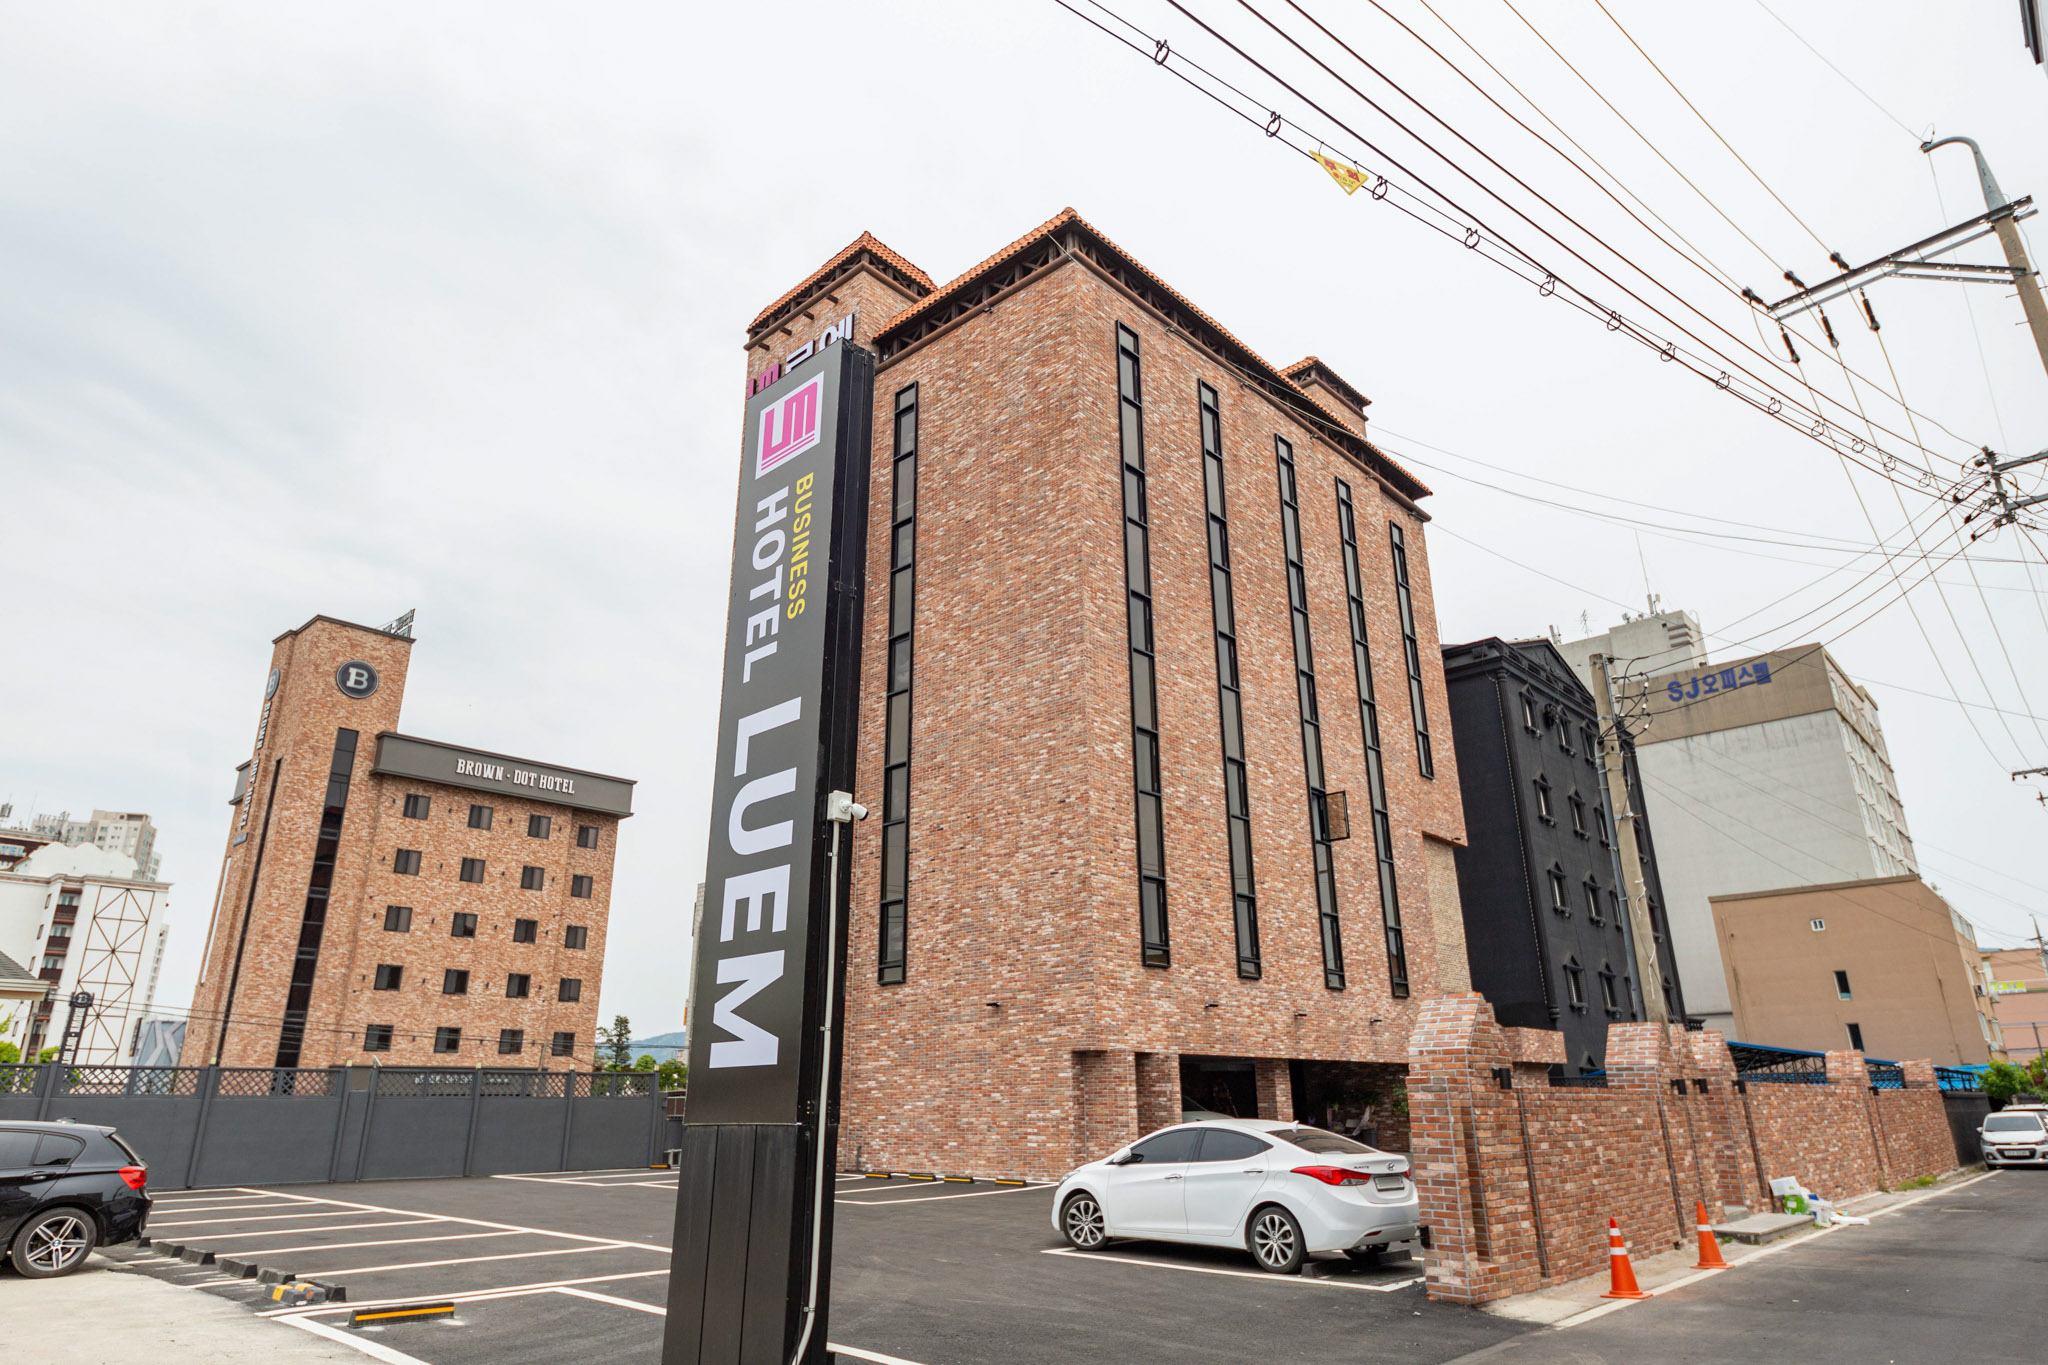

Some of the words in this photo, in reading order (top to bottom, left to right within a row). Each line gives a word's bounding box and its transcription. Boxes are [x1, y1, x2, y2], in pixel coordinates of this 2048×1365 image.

[743, 486, 789, 684] HOTEL
[787, 472, 814, 620] BUSINESS
[346, 666, 369, 690] B
[456, 758, 504, 781] BROWN
[513, 769, 537, 787] DOT
[539, 774, 575, 794] HOTEL
[0, 845, 25, 857] TEL
[709, 696, 802, 1069] LUEM
